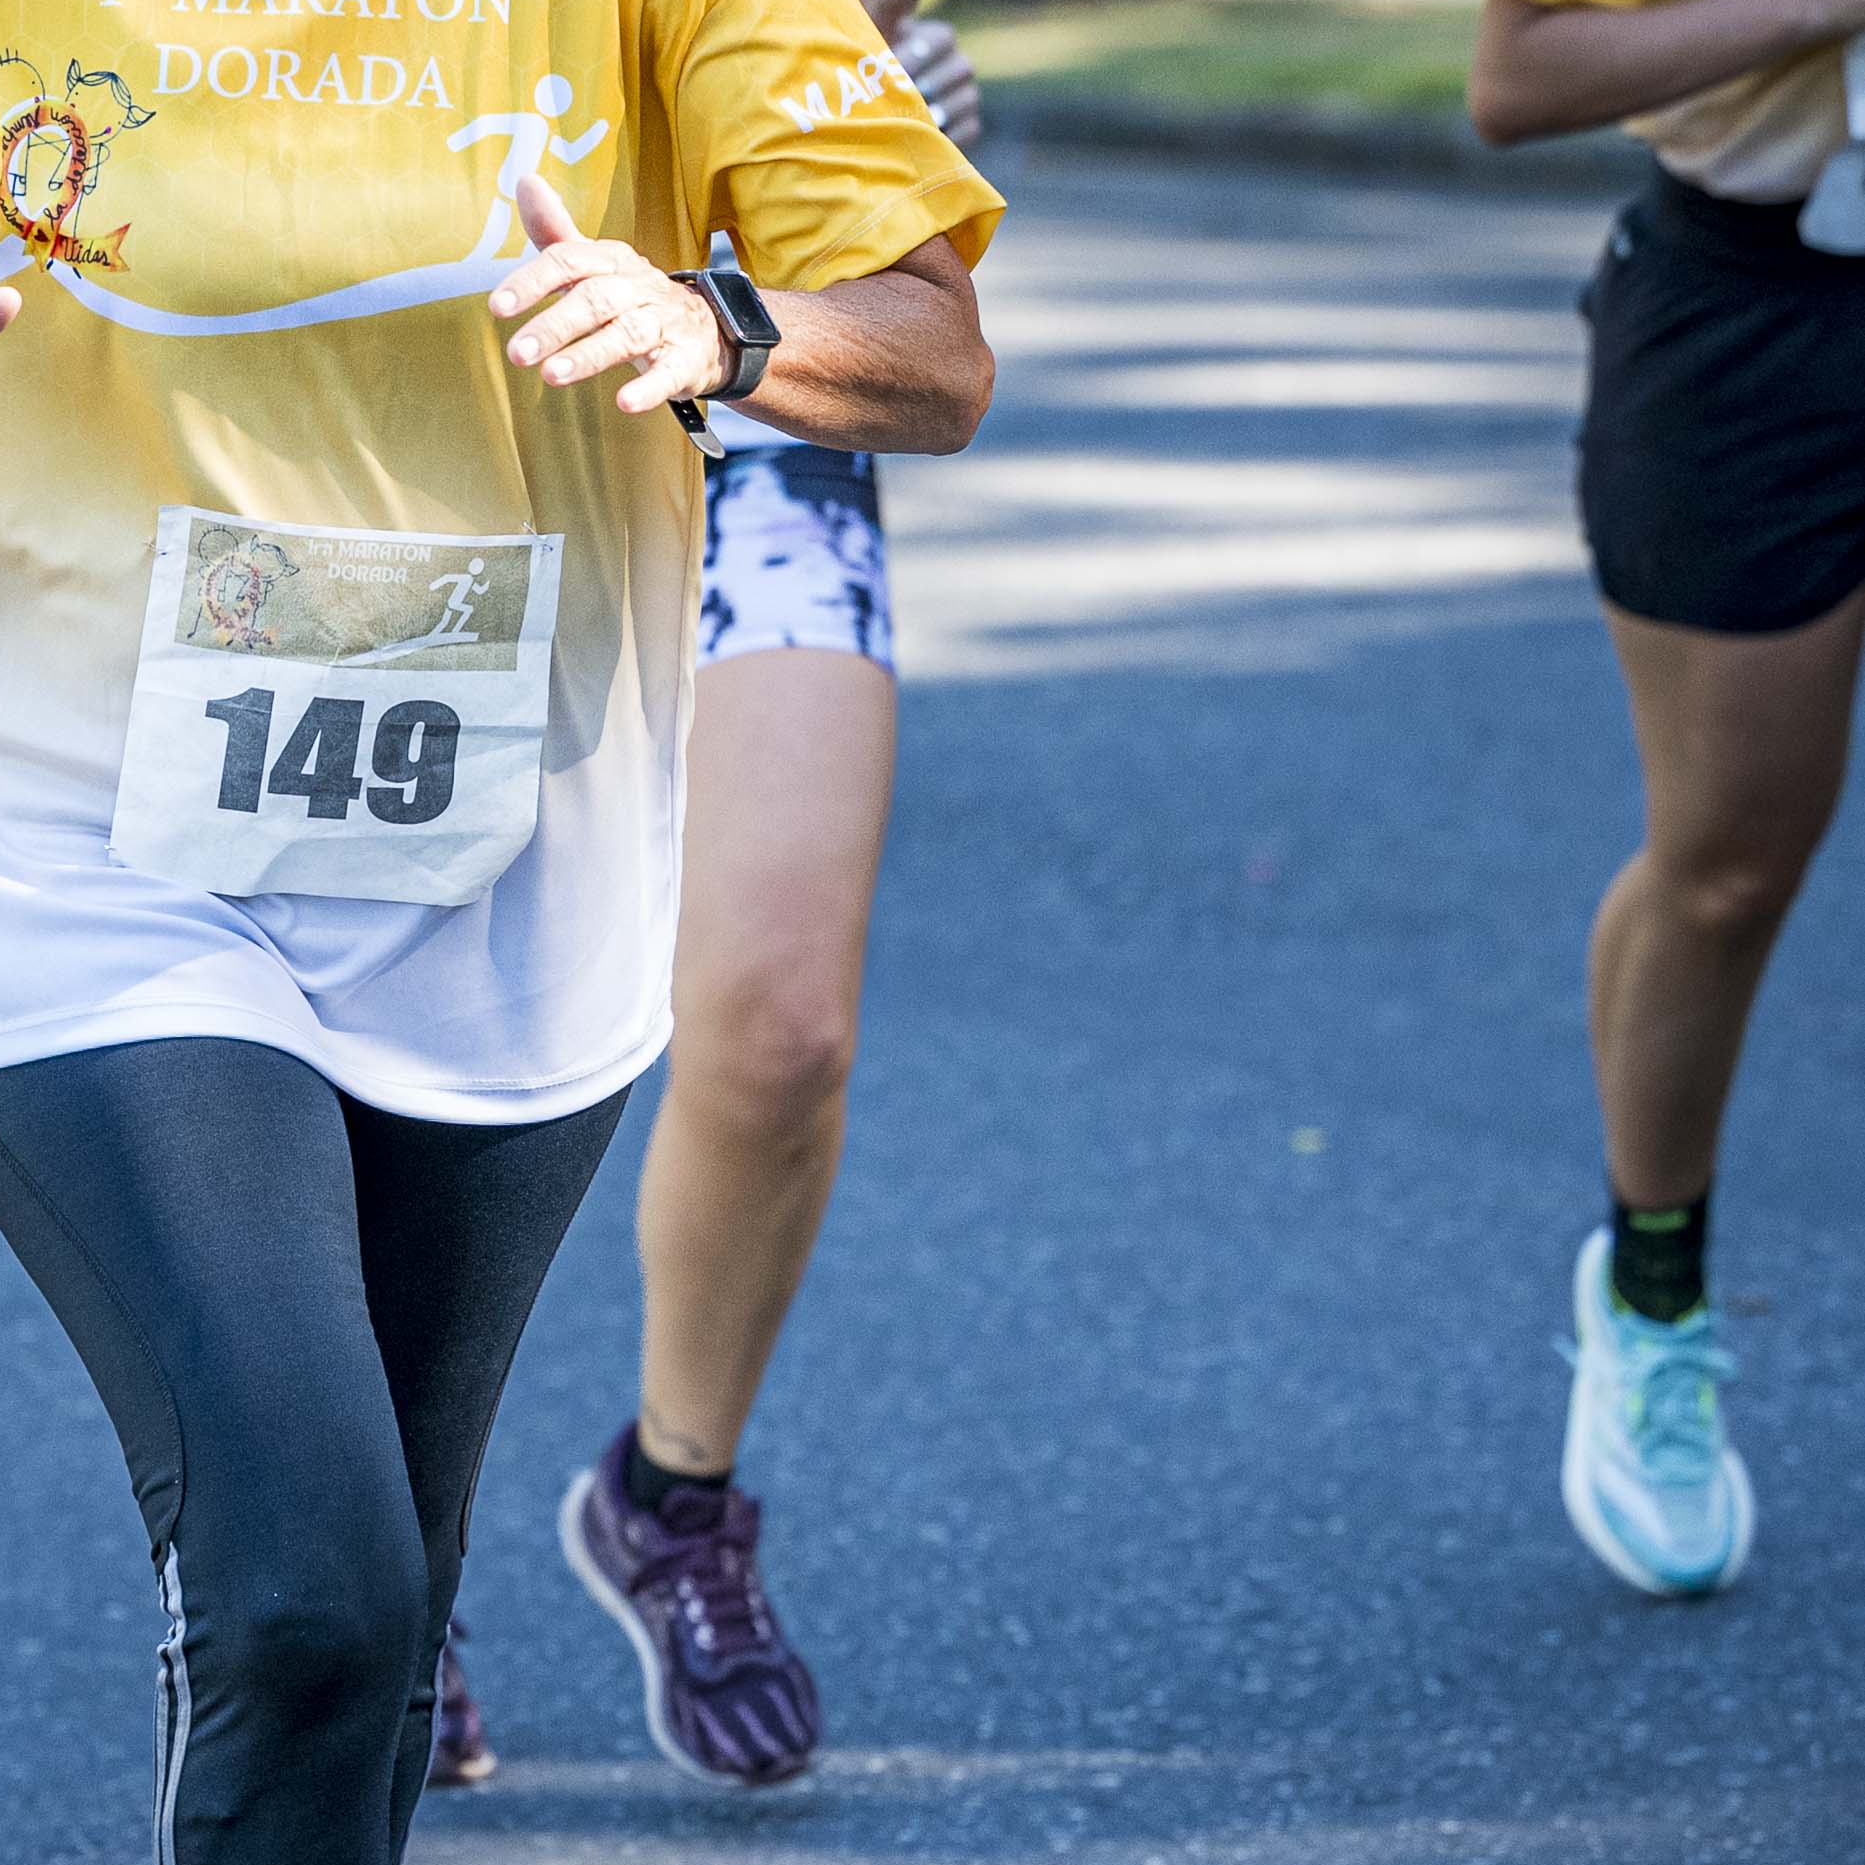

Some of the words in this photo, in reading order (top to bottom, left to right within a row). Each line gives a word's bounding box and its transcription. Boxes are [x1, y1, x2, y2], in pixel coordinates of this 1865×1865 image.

[152, 43, 455, 110] DORADA
[327, 562, 409, 584] DORADA
[205, 687, 461, 825] 149
